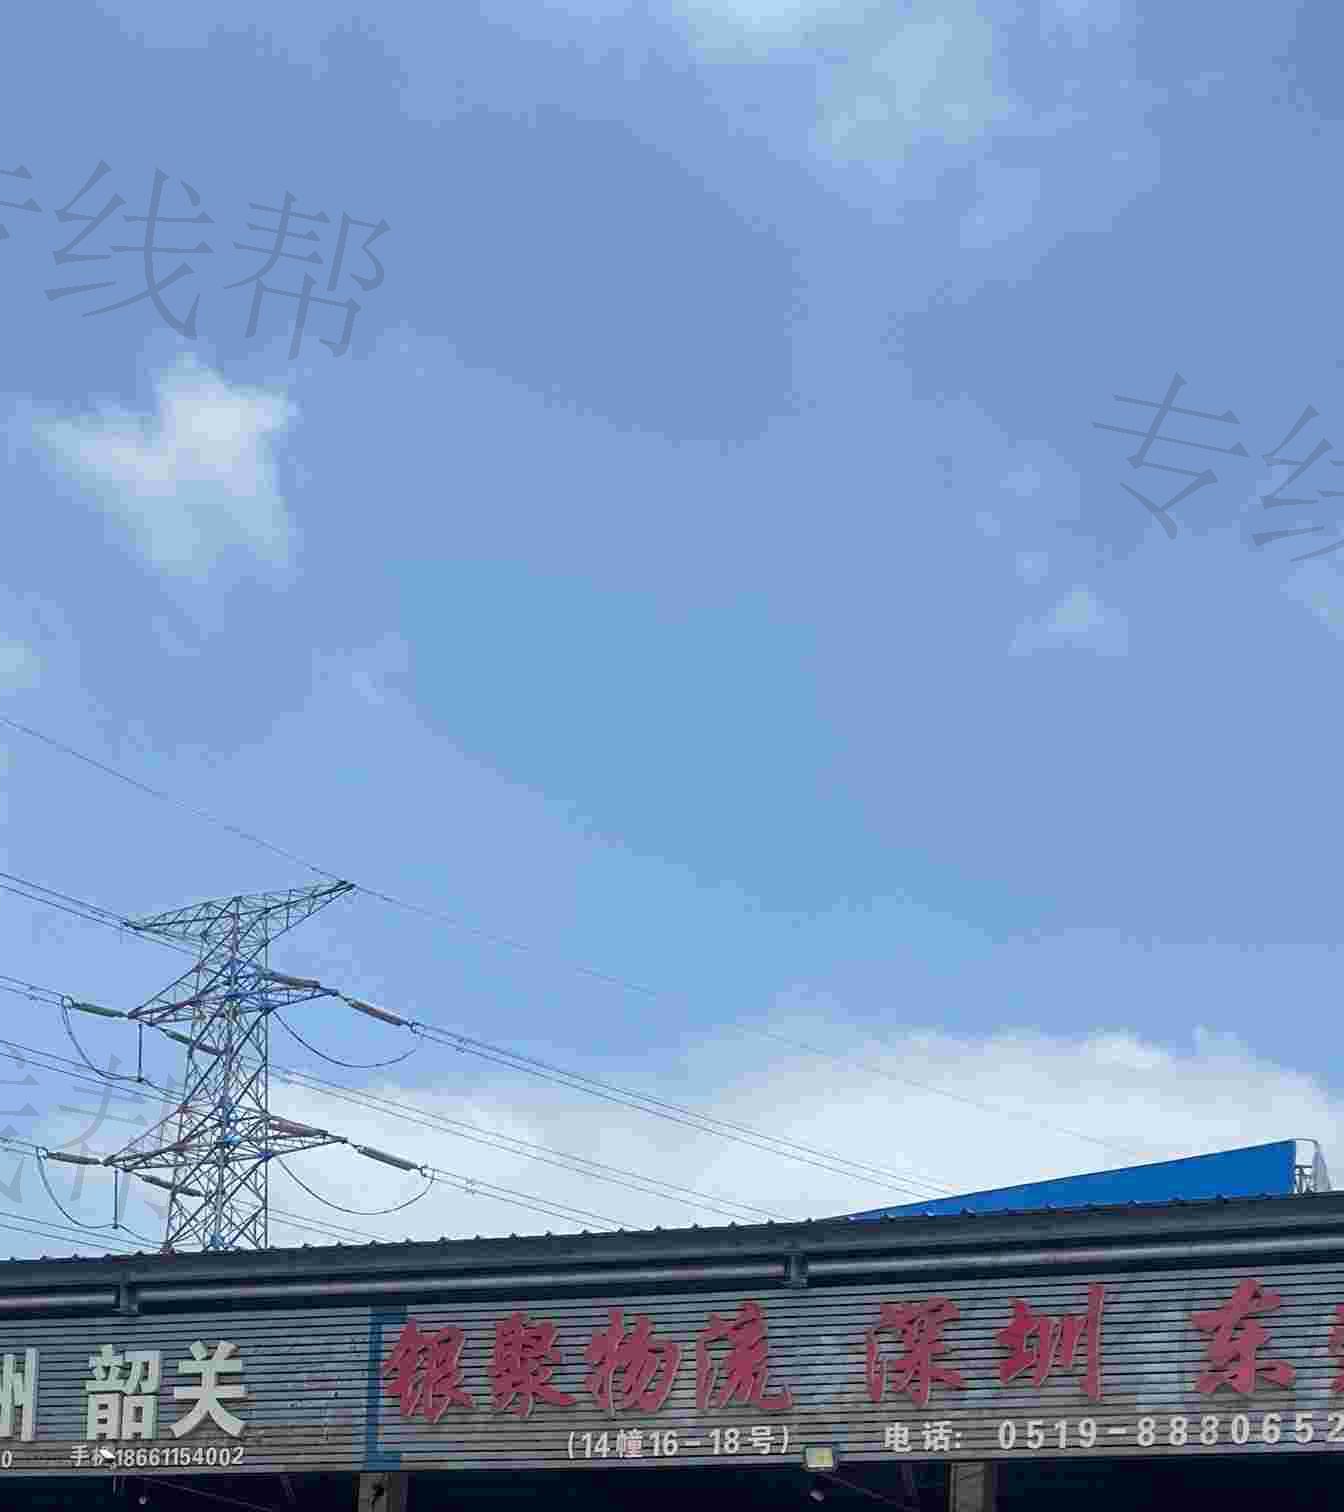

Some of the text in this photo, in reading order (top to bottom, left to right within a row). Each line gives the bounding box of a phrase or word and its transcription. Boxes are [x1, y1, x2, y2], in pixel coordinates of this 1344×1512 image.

[83, 1340, 251, 1443] 韶关
[381, 1300, 793, 1426] 银聚物流
[863, 1281, 1106, 1406] 深圳
